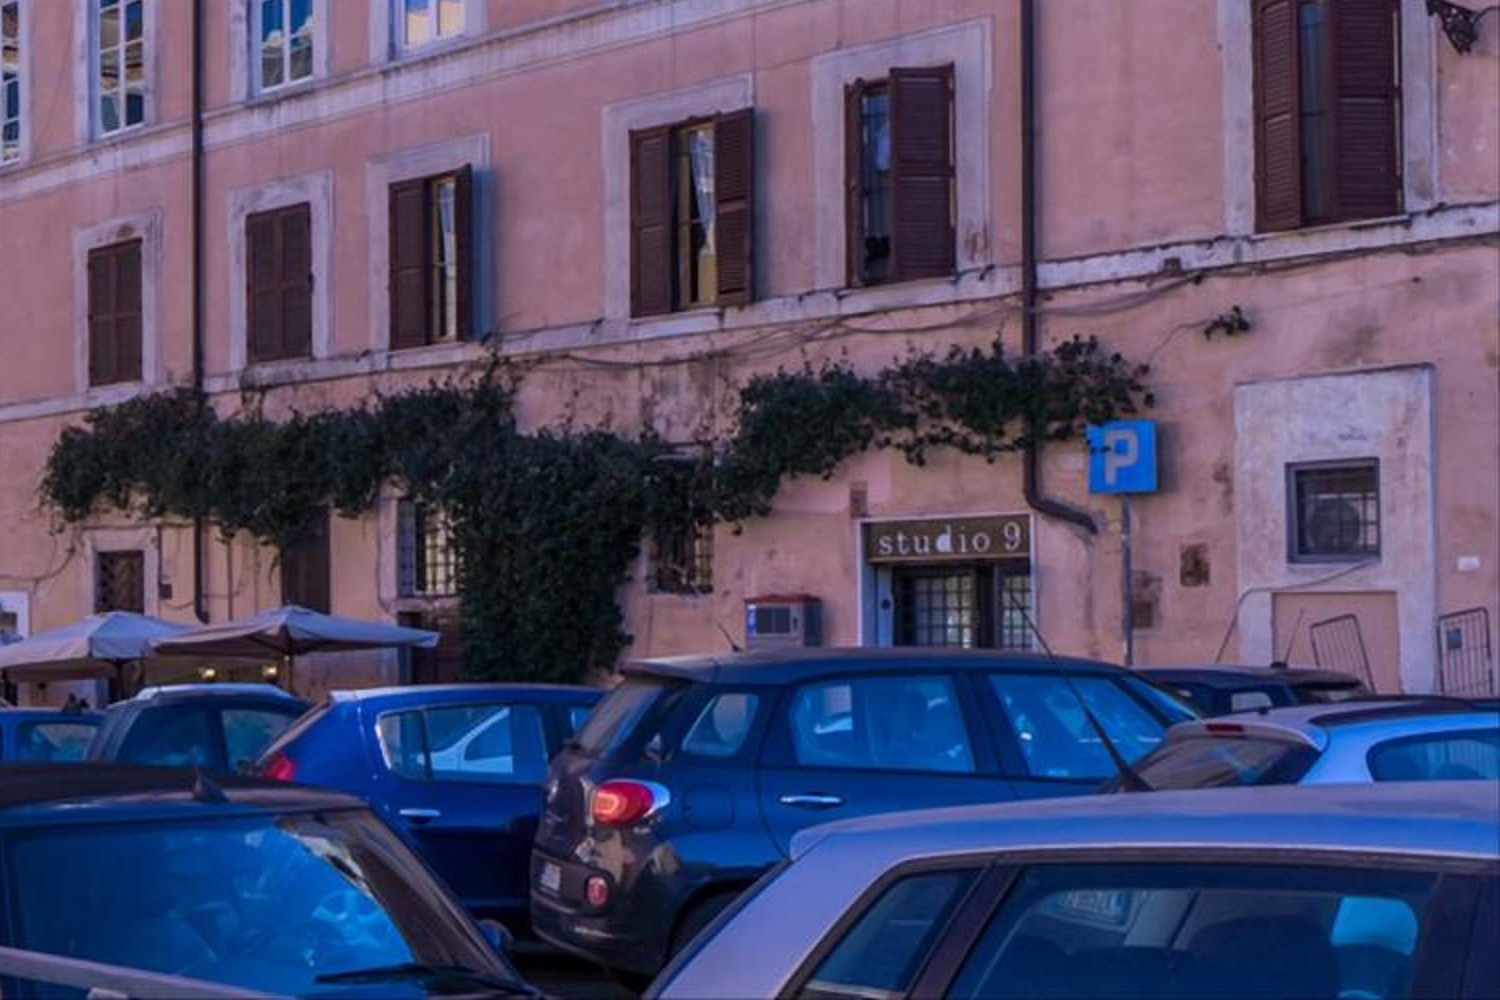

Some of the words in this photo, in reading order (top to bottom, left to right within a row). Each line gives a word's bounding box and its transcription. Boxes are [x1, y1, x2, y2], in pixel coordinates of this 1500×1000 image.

[1105, 429, 1139, 485] P
[878, 524, 991, 555] studio
[1003, 521, 1021, 551] 9
